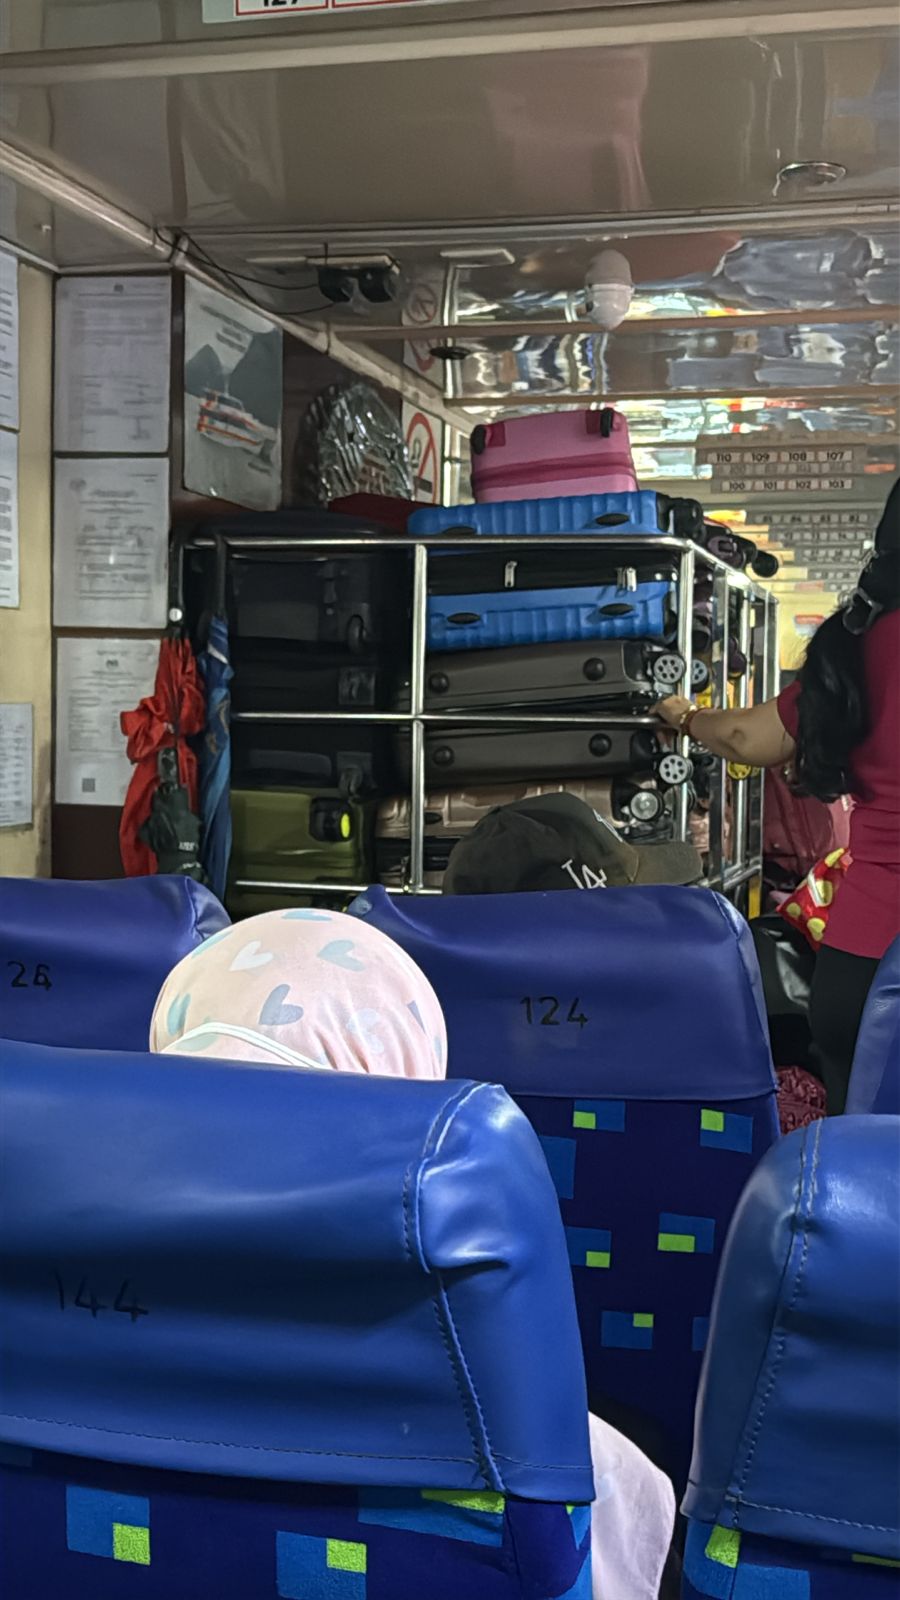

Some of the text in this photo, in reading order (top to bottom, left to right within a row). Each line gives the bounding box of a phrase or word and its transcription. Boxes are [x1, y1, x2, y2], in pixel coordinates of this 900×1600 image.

[717, 451, 844, 463] 110 109 108 107
[730, 480, 845, 490] 100 101 102 103
[520, 996, 588, 1029] 124
[52, 1271, 148, 1322] 144
